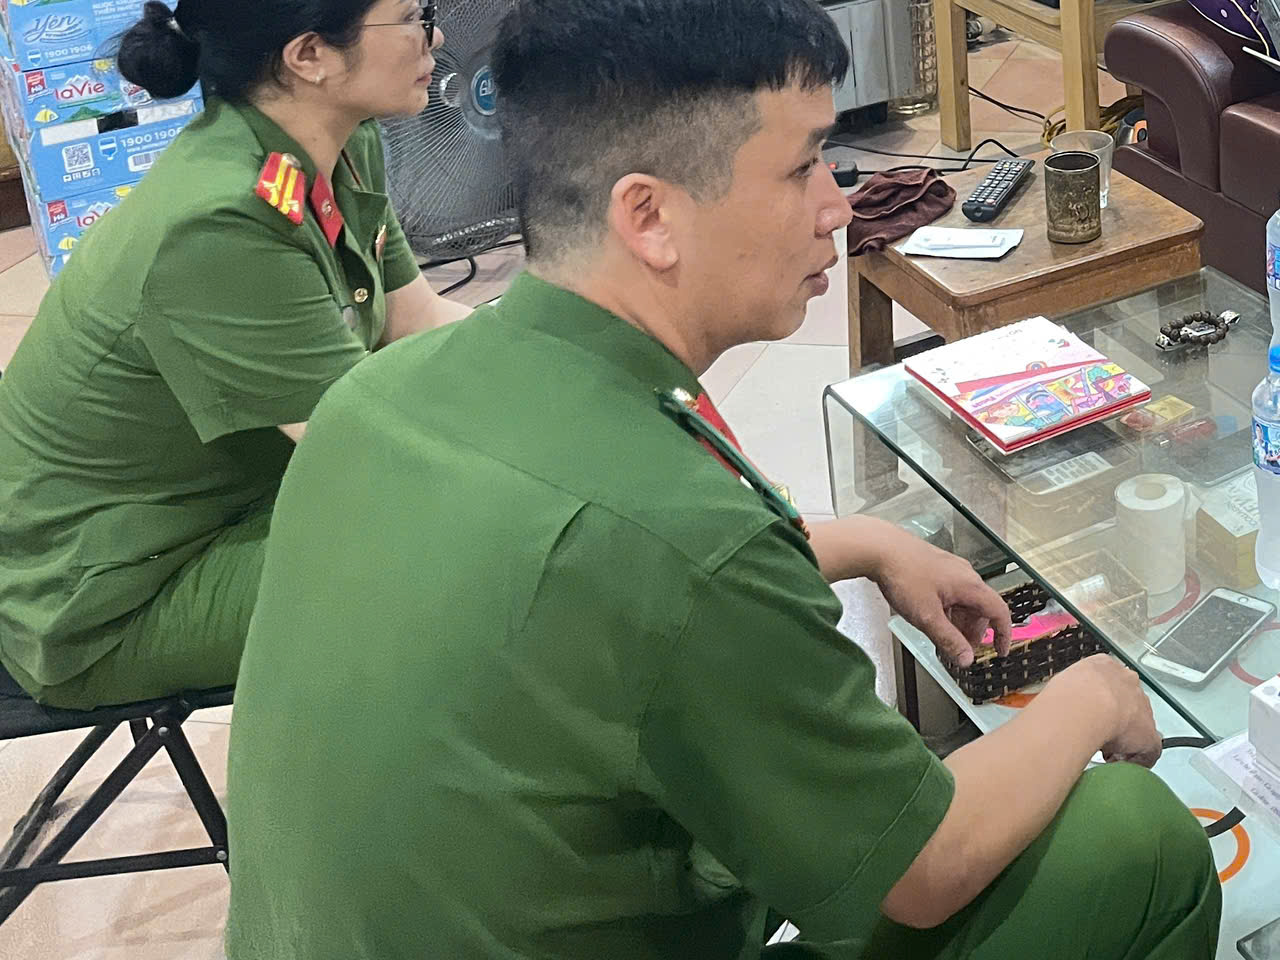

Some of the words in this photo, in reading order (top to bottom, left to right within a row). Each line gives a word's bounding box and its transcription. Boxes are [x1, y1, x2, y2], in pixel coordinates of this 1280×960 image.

[44, 46, 69, 58] 1900
[54, 81, 105, 101] laVie
[120, 135, 152, 148] 1900
